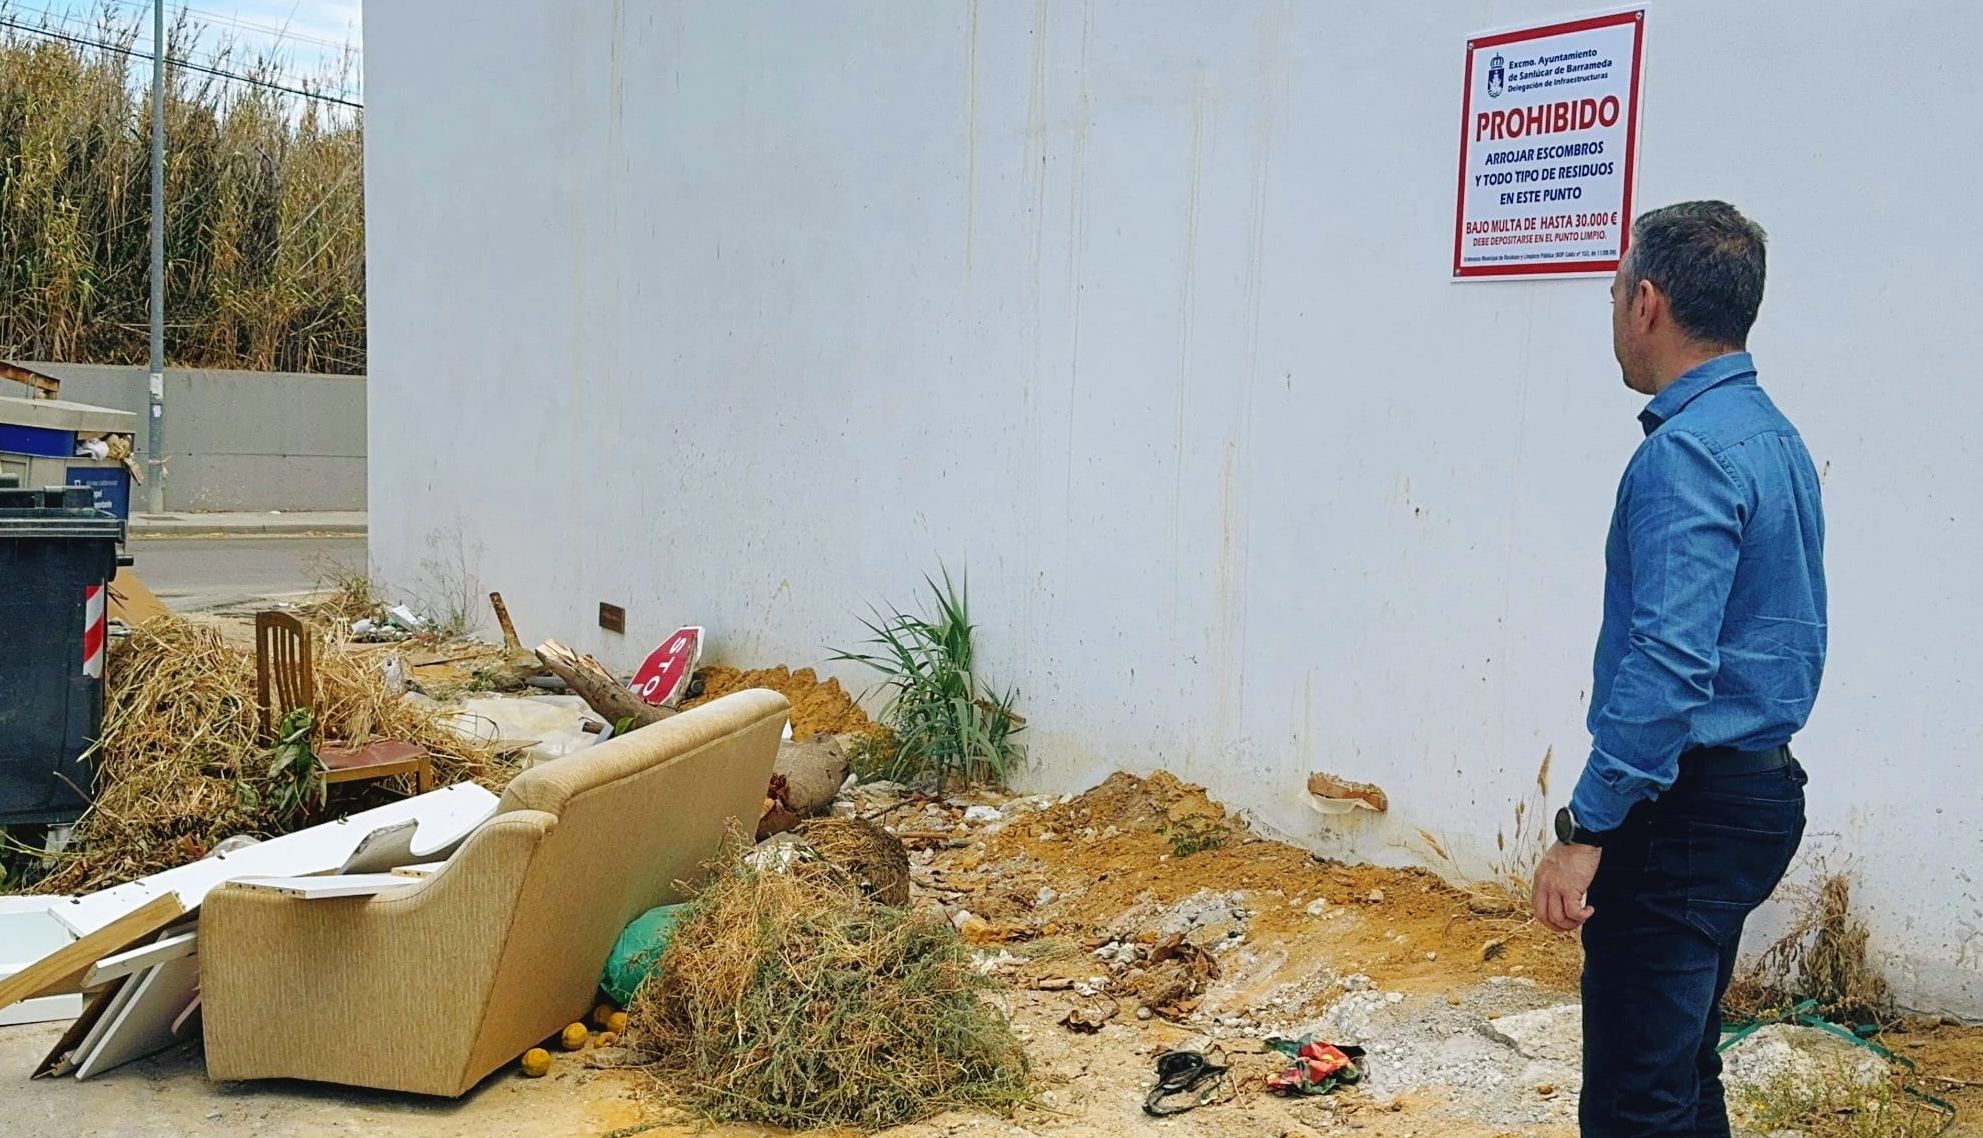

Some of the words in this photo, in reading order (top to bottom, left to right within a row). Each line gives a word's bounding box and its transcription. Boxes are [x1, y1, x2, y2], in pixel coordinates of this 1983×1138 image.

[1508, 74, 1517, 82] de
[1520, 68, 1552, 80] Sanlúcar
[1554, 66, 1564, 75] de
[1566, 59, 1612, 73] Barrameda
[1509, 60, 1536, 69] Excmo.
[1538, 49, 1597, 66] Ayuntamiento
[1508, 81, 1543, 92] Delegación
[1544, 79, 1552, 87] de
[1554, 72, 1608, 86] Infraestructuras
[1476, 95, 1620, 142] PROHIBIDO
[1485, 149, 1534, 165] ARROJAR
[1537, 141, 1604, 160] ESCOMBROS
[1475, 175, 1481, 187] Y
[1484, 172, 1513, 186] TODO
[1515, 169, 1539, 183] TIPO
[1541, 168, 1556, 181] DE
[1559, 162, 1614, 179] RESIDUOS
[1500, 192, 1514, 205] EN
[1517, 190, 1541, 204] ESTE
[1544, 187, 1582, 201] PUNTO
[1466, 221, 1489, 234] BAJO
[1491, 218, 1522, 232] MULTA
[1524, 217, 1536, 230] DE
[1540, 215, 1573, 229] HASTA
[1575, 212, 1608, 227] 30.000
[1611, 211, 1617, 225] €
[1473, 238, 1490, 246] DEBE
[1491, 234, 1533, 245] DEPOSITARSE
[1534, 233, 1544, 243] EN
[1545, 233, 1553, 242] EL
[1555, 231, 1579, 242] PUNTO
[1580, 230, 1607, 241] LIMPIO.
[643, 637, 686, 696] STO
